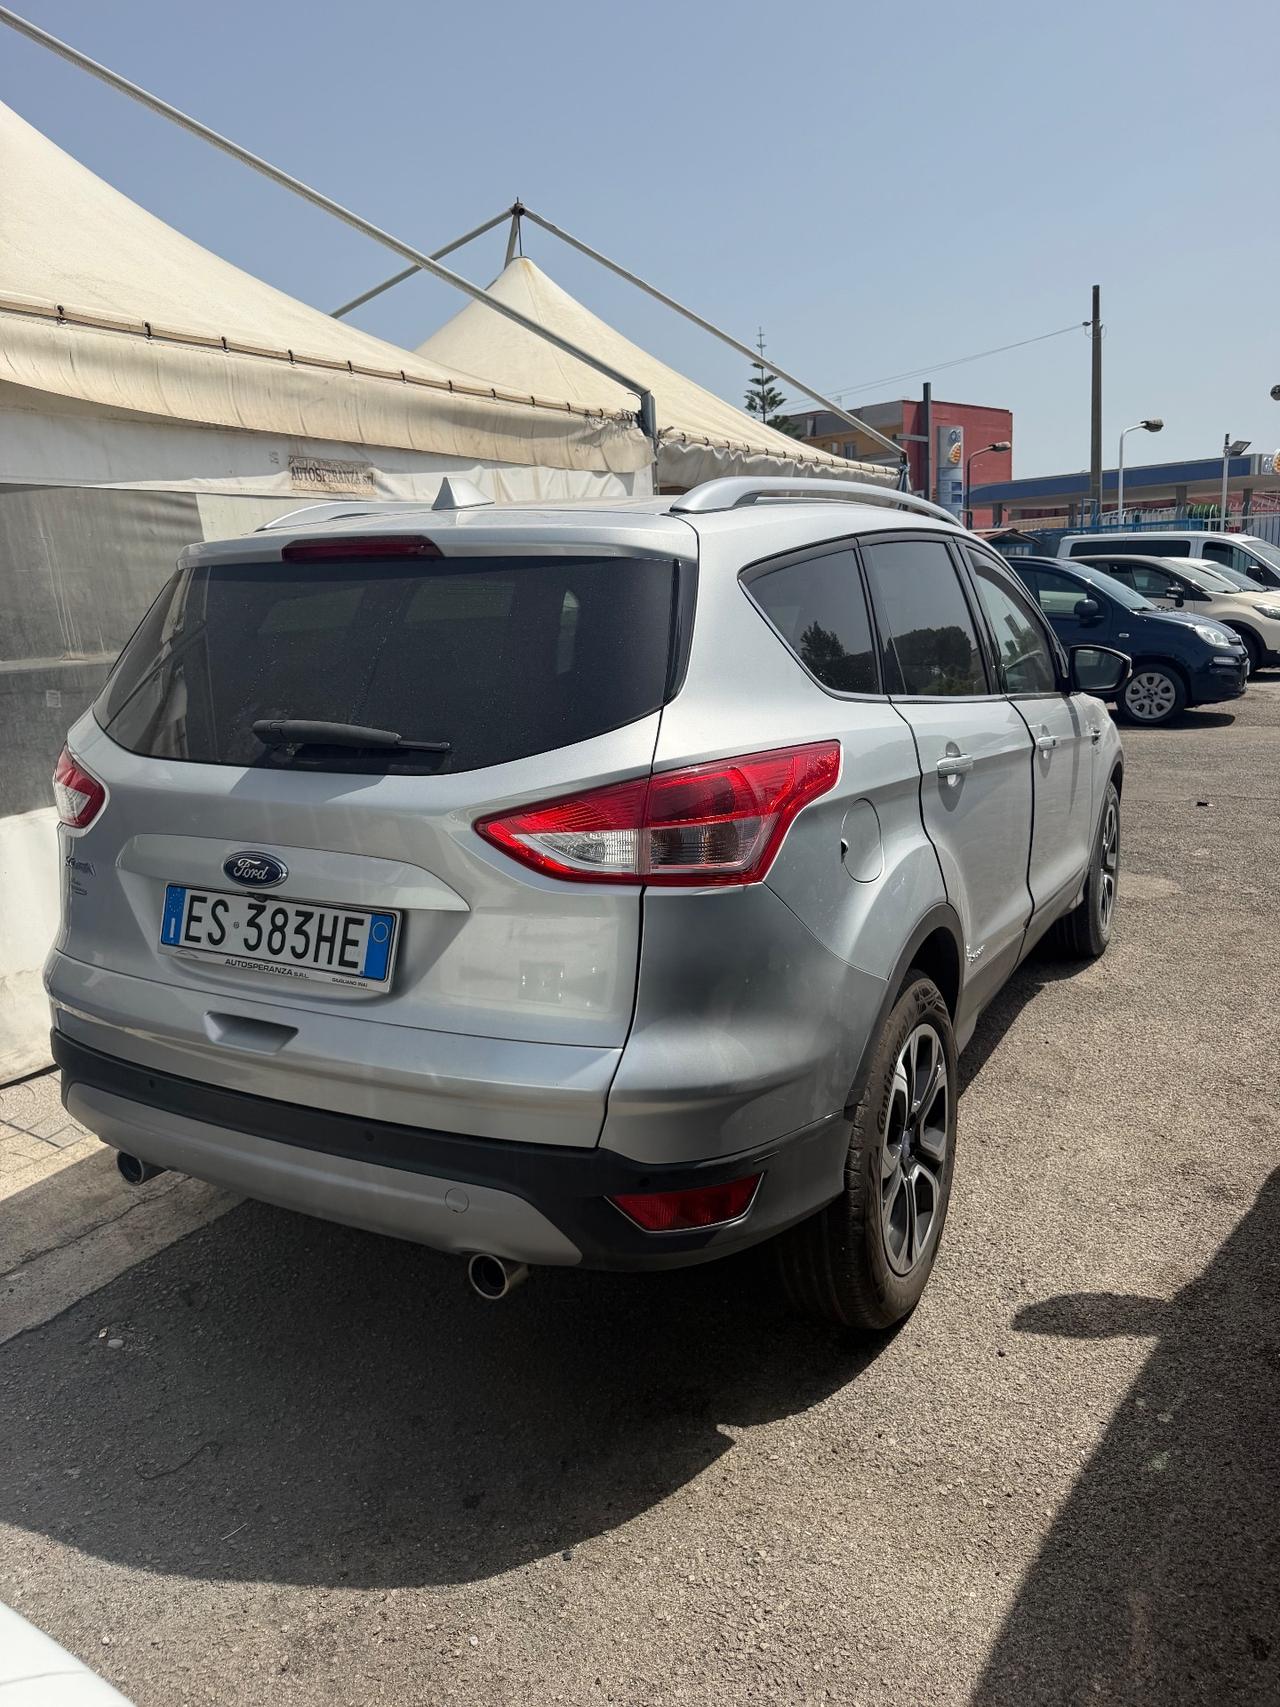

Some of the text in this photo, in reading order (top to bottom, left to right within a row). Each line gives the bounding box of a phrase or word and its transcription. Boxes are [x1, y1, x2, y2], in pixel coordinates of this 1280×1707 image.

[291, 466, 361, 484] AUTOSPERANZA
[233, 858, 269, 880] Ford
[184, 894, 365, 969] ES 383HE
[224, 958, 293, 976] AUTOSPERANZA
